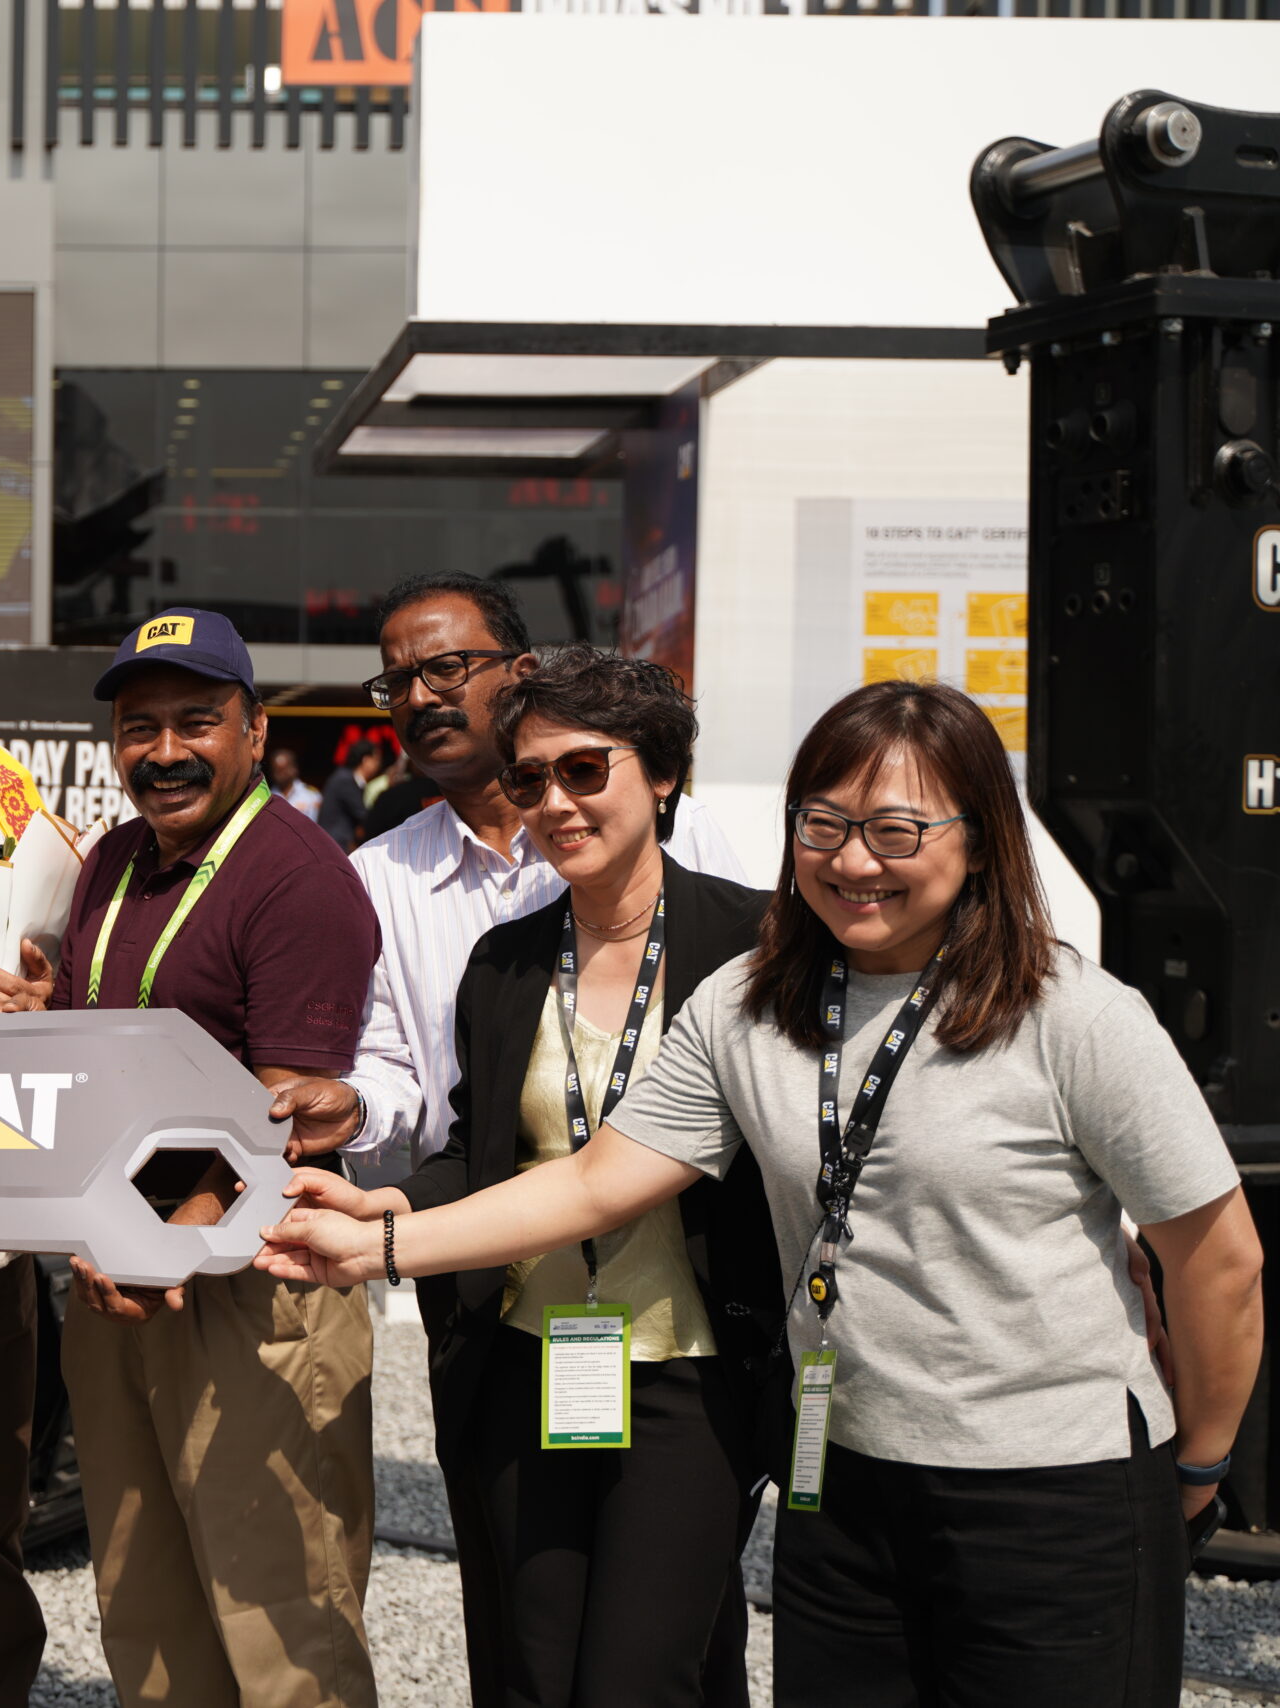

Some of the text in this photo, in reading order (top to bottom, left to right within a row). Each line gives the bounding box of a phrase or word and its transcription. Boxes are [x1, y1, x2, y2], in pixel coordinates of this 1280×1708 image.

[147, 623, 181, 640] CAT
[646, 942, 661, 964] CAT
[635, 985, 649, 1008] CAT
[826, 1004, 841, 1028] CAT
[623, 1028, 638, 1051] CAT
[885, 1029, 905, 1055] CAT
[824, 1052, 838, 1076] CAT
[567, 1072, 579, 1095] CAT
[611, 1072, 626, 1095] CAT
[862, 1074, 881, 1099] CAT
[821, 1100, 835, 1125] CAT
[572, 1117, 587, 1139] CAT
